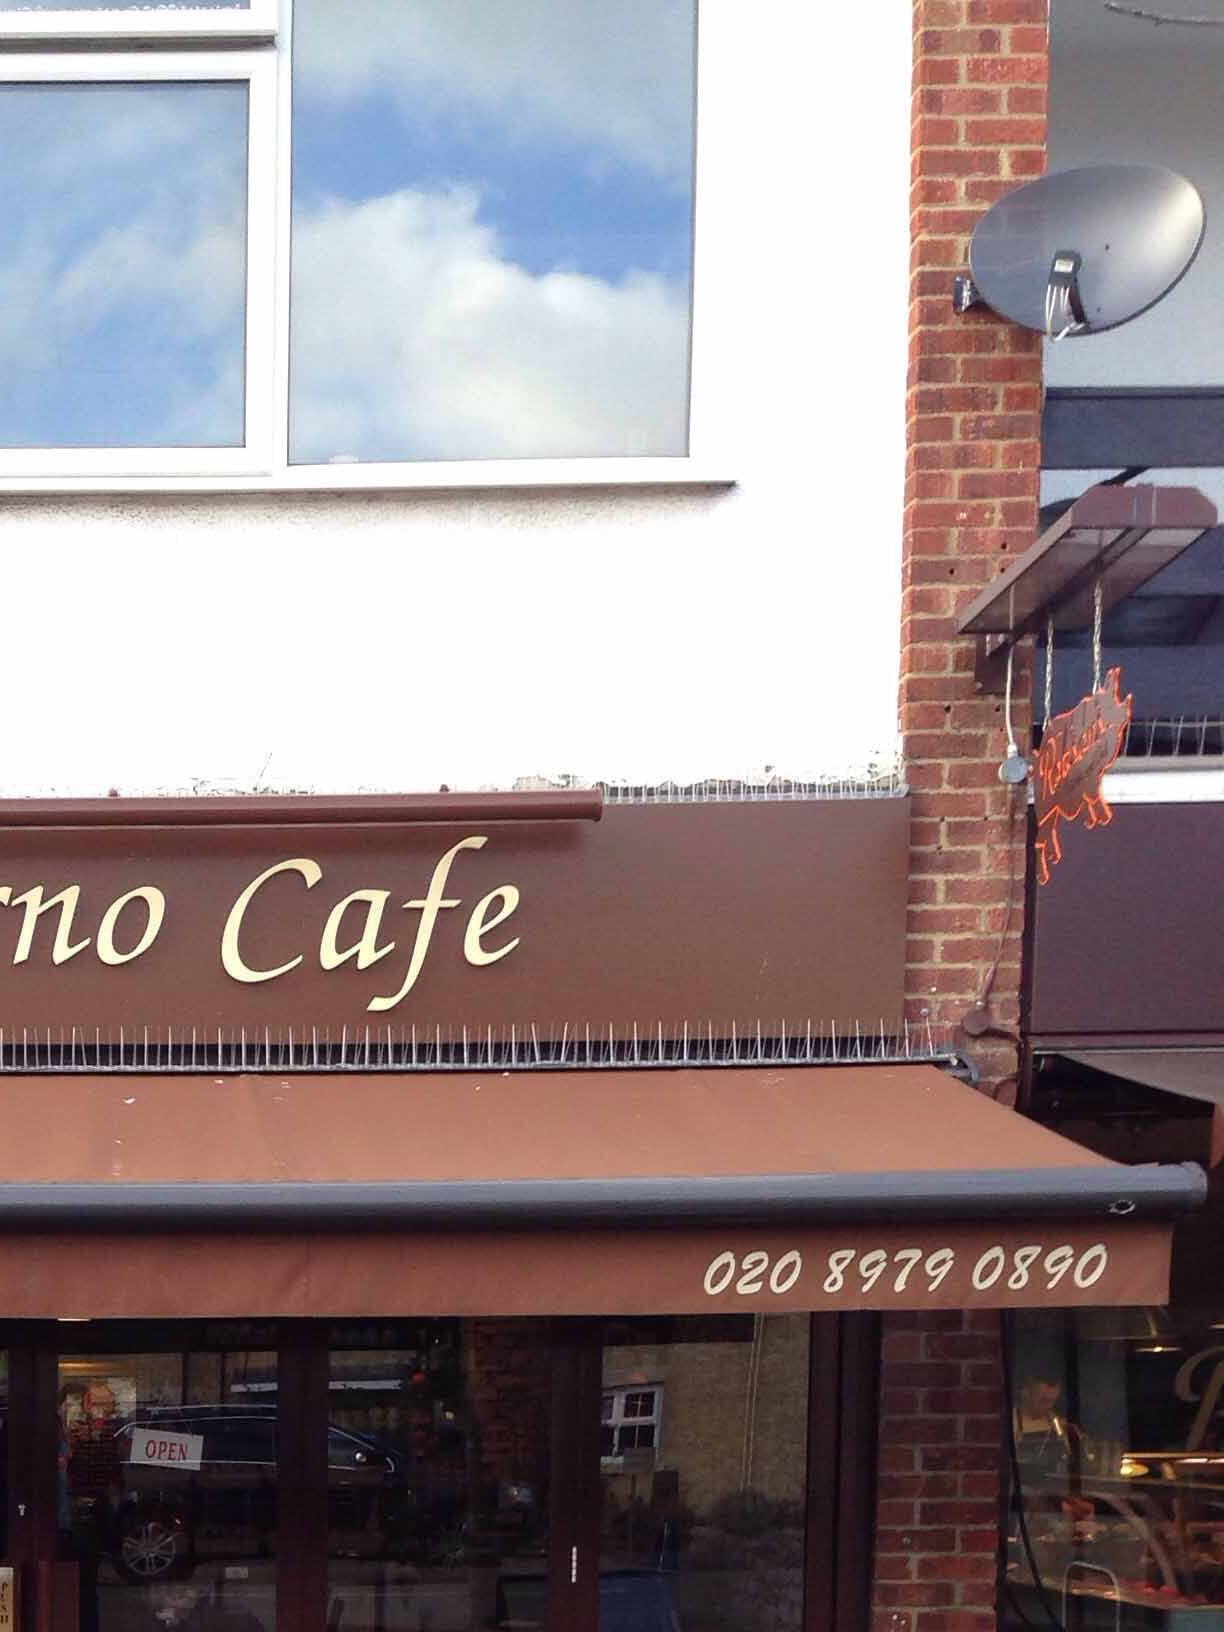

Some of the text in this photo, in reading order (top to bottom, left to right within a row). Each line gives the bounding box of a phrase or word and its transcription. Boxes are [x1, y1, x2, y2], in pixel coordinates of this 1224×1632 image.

[221, 836, 520, 1011] Cafe
[703, 1244, 1108, 1295] 020 8979 0890
[145, 1439, 189, 1461] OPEN
